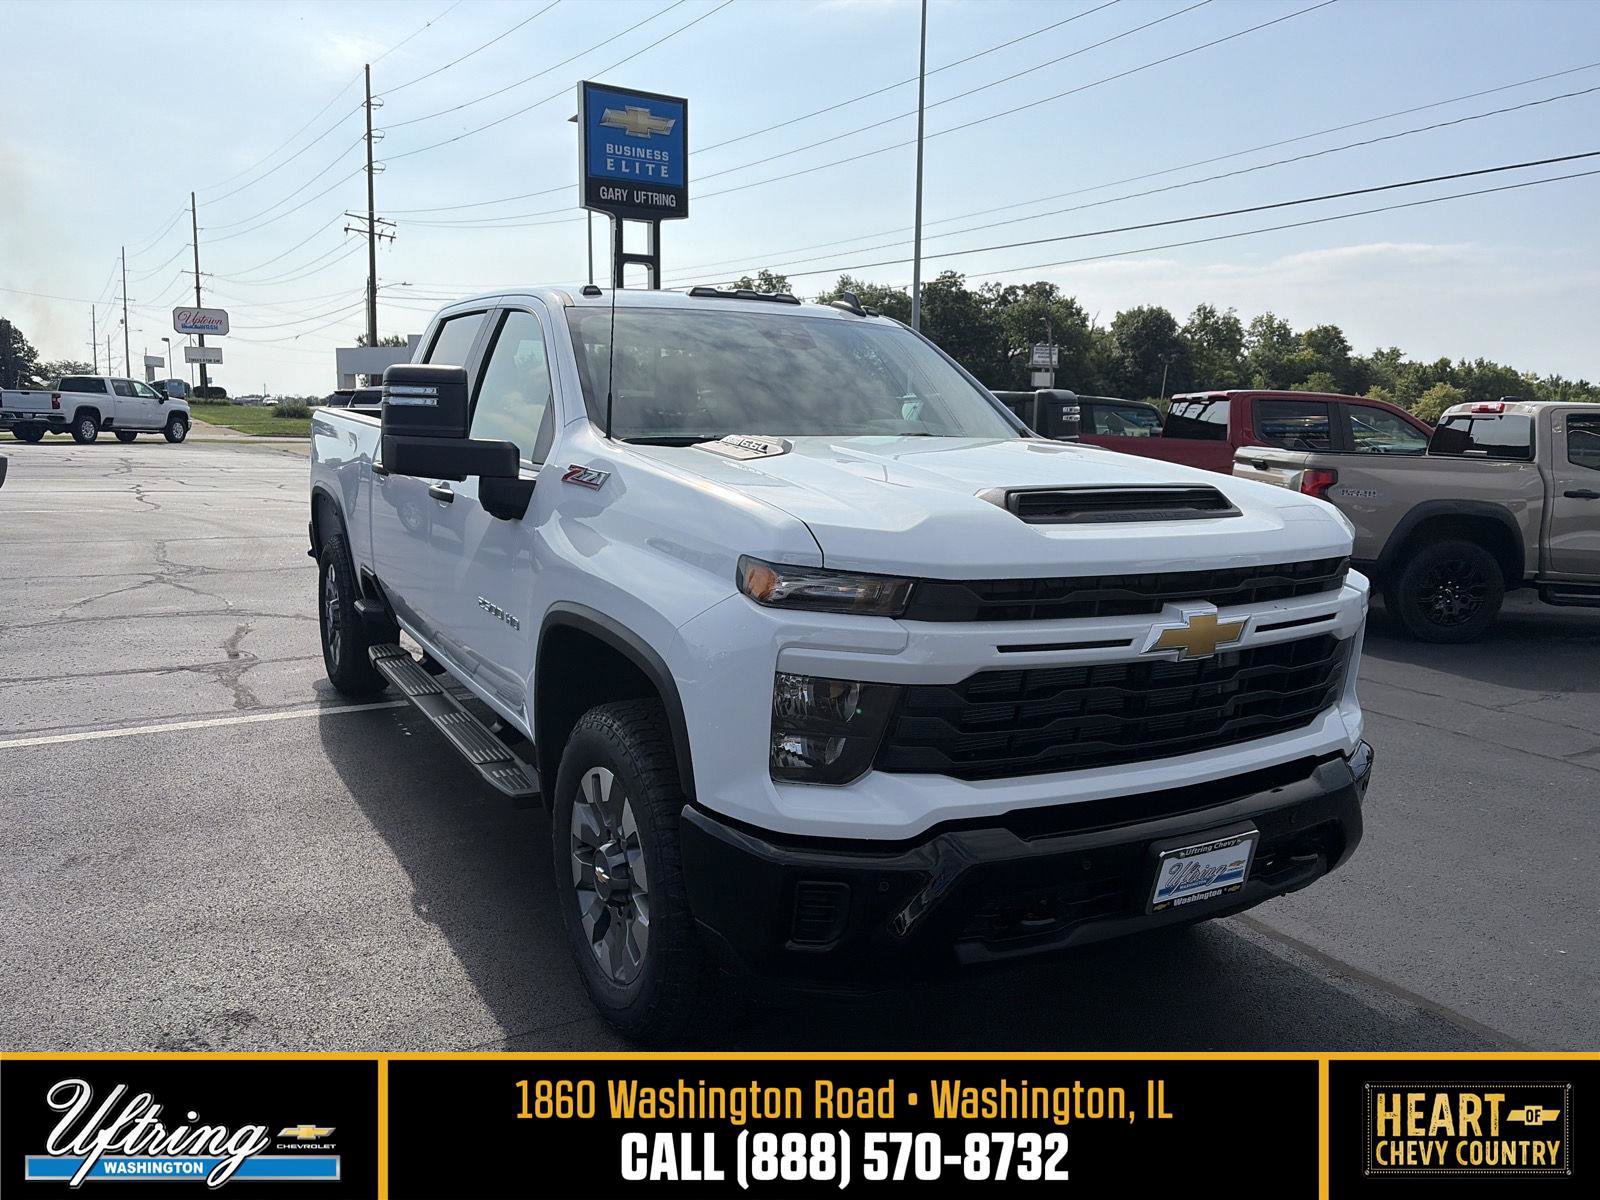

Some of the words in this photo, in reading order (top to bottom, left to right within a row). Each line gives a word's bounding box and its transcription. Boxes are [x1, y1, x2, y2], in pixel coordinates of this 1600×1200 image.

[606, 143, 669, 161] BUSINESS
[606, 158, 669, 178] ELITE
[600, 186, 628, 201] GARY
[633, 191, 676, 207] UFTRING
[177, 310, 223, 325] Uptown
[1185, 845, 1213, 856] Uftring
[1173, 889, 1222, 906] Washington
